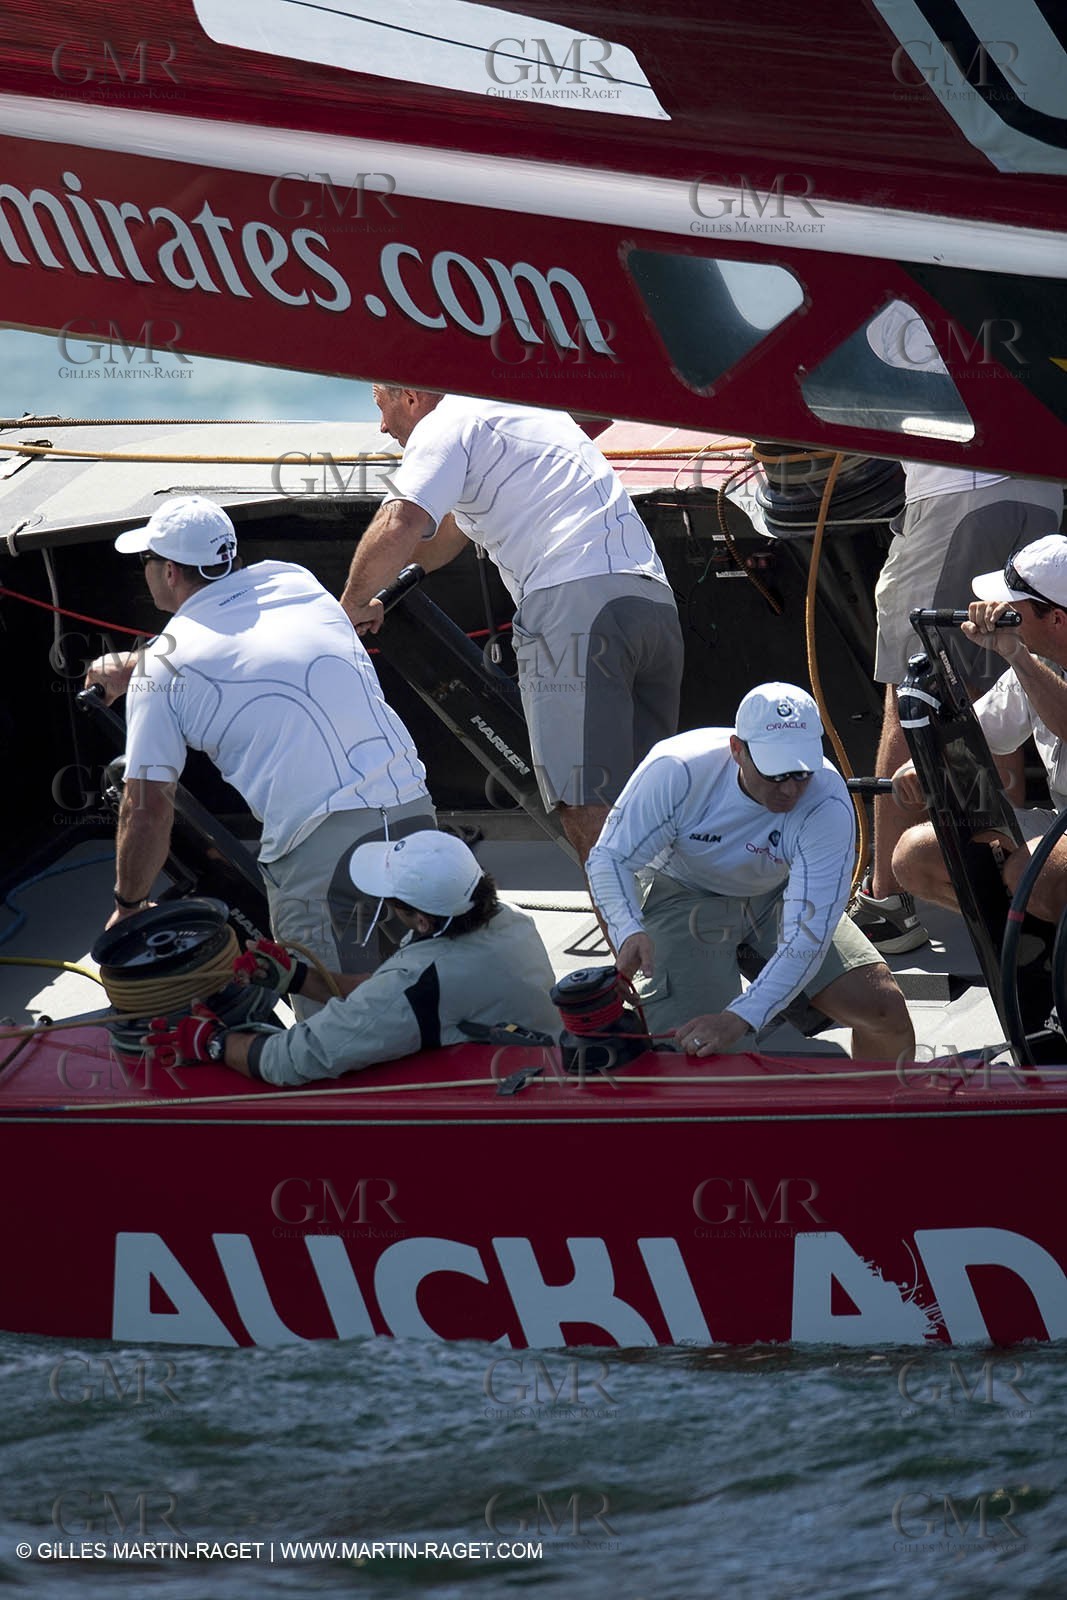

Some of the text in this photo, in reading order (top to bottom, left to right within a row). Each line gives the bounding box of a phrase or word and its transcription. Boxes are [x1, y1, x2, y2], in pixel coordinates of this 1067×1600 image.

[0, 171, 616, 355] mirates.com
[470, 715, 531, 775] HARKEN
[766, 722, 807, 731] ORACLE
